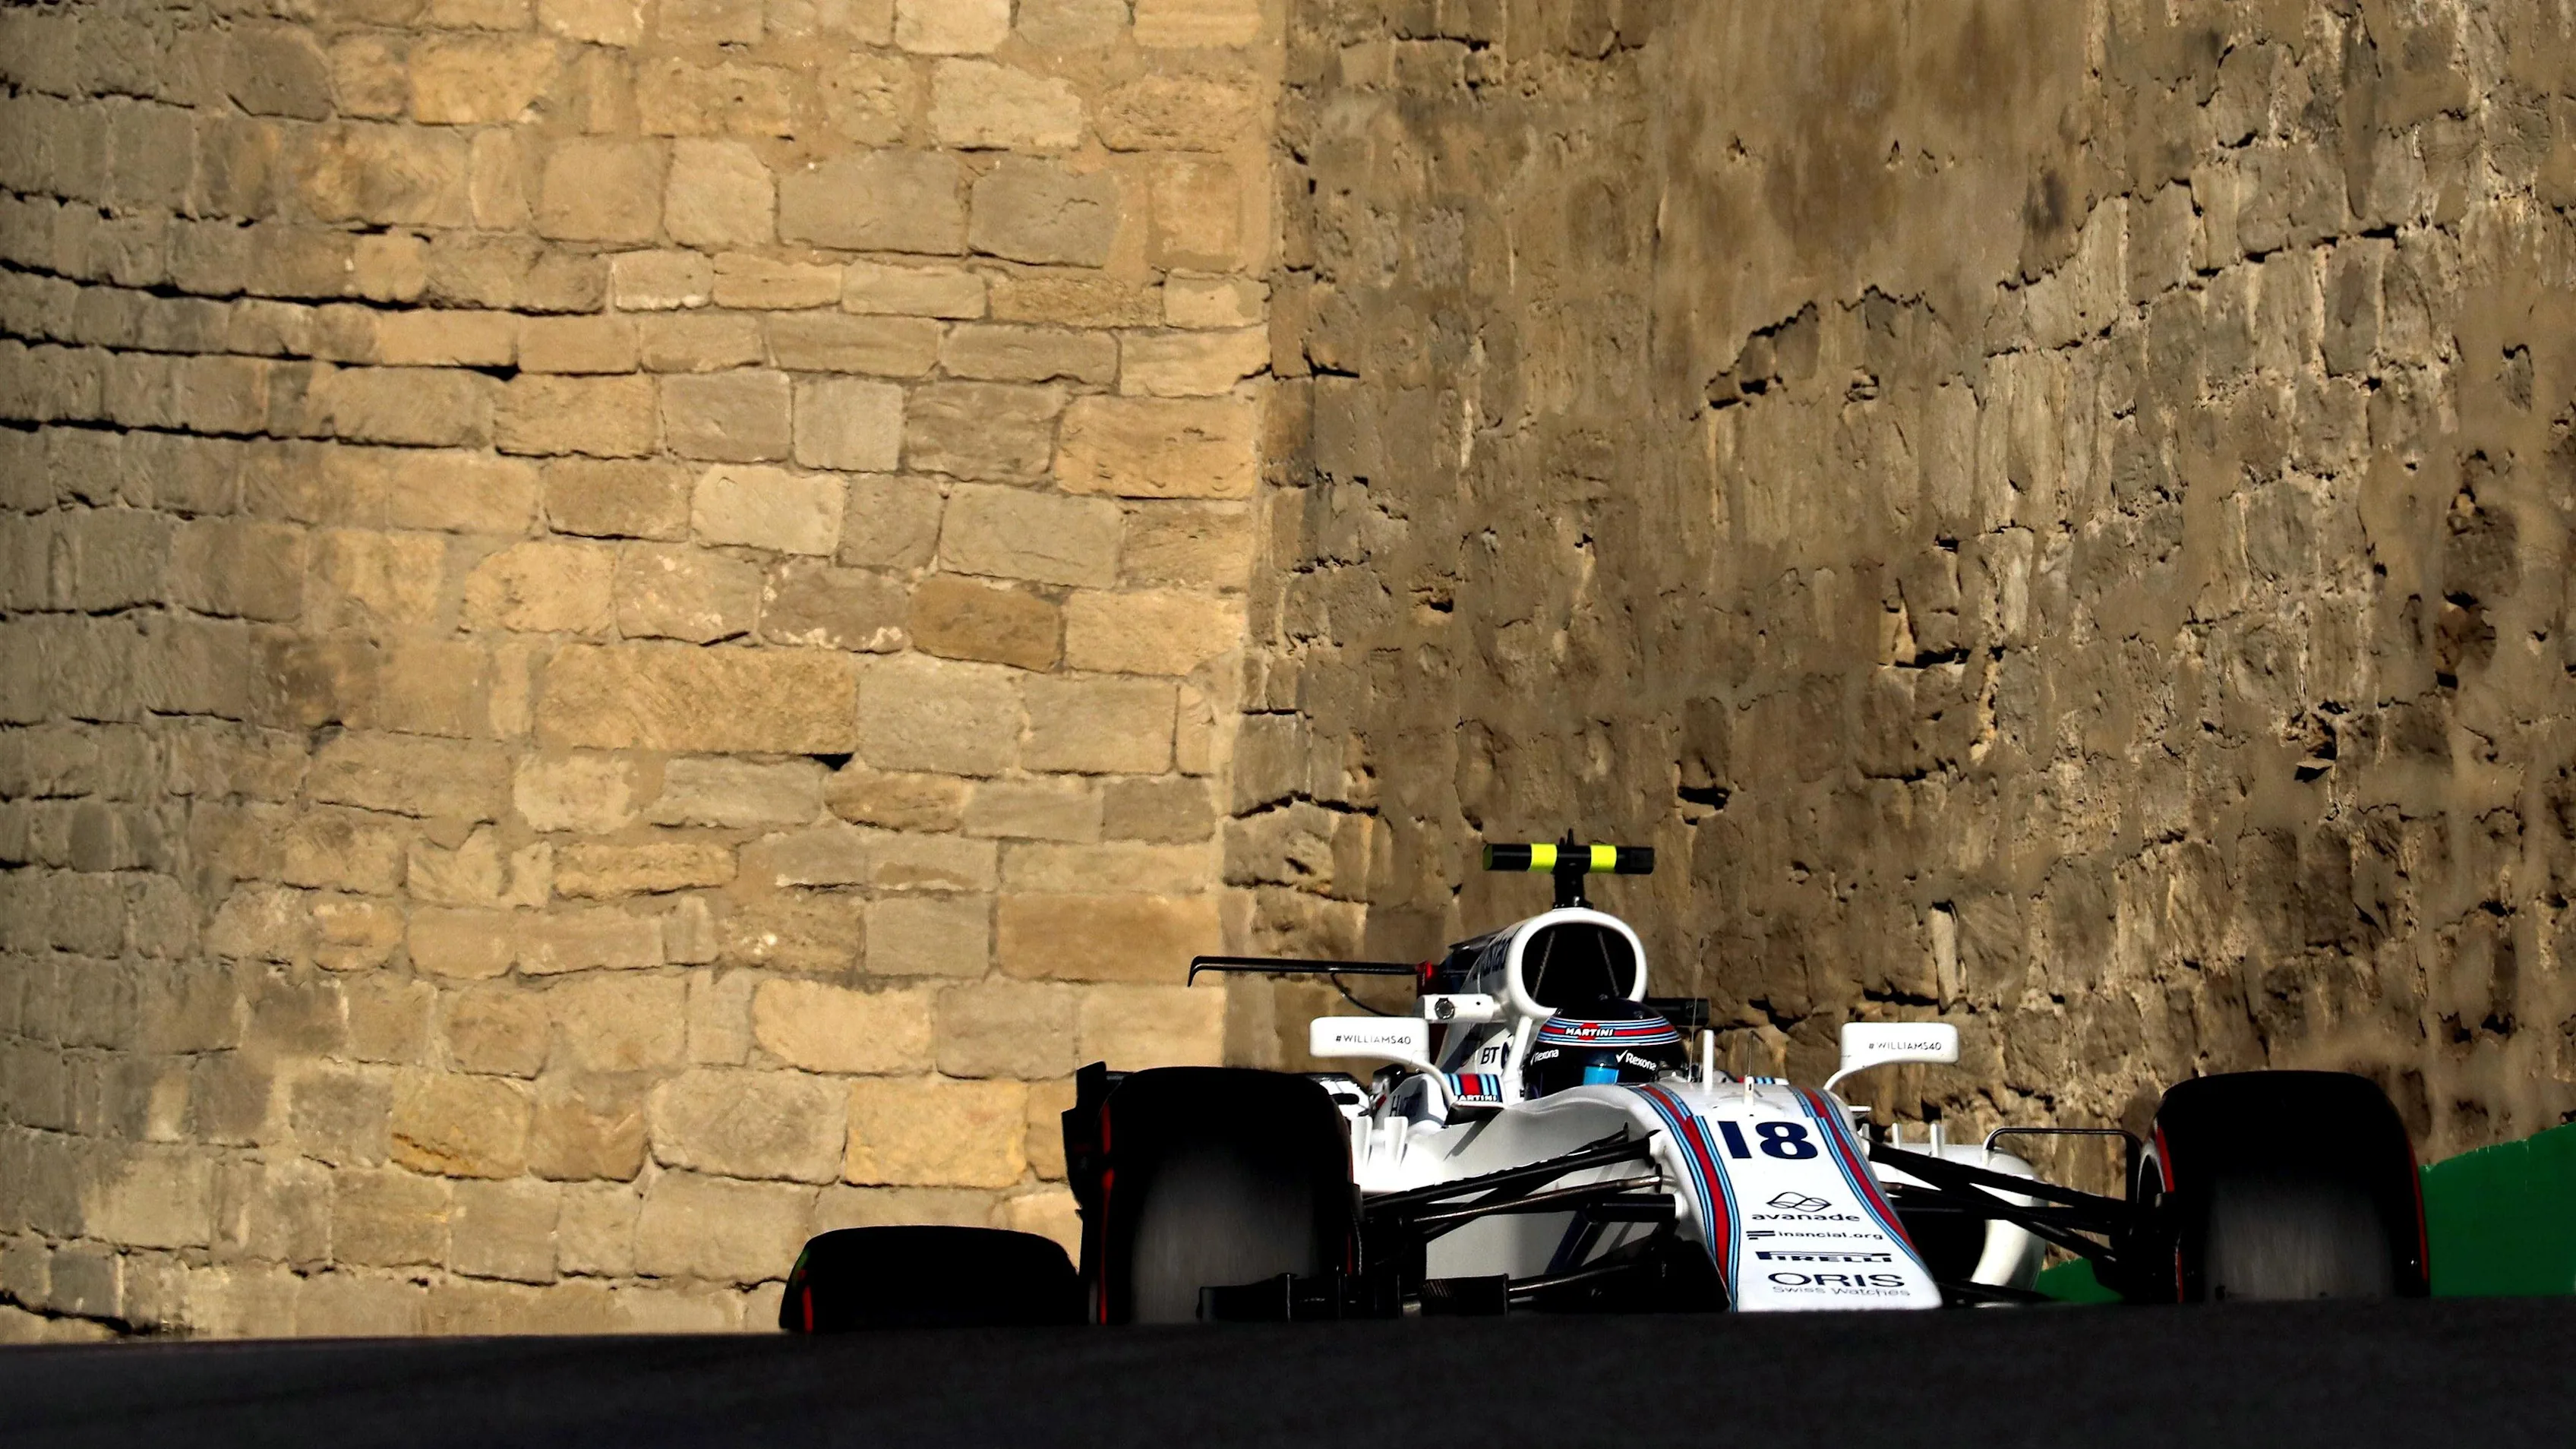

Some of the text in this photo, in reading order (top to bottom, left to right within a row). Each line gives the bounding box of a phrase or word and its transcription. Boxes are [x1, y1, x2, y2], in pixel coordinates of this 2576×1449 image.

[1564, 1028, 1614, 1037] MARTINI
[1336, 1035, 1411, 1045] #WILLIAMS40
[1868, 1041, 1942, 1050] #WILLIAMS40
[1481, 1046, 1500, 1065] BT
[1625, 1052, 1658, 1071] Rexona
[1717, 1120, 1819, 1160] 18
[1755, 1251, 1893, 1263] PIRELLI
[1768, 1272, 1905, 1287] ORIS
[1772, 1286, 1911, 1297] Swiss Watches
